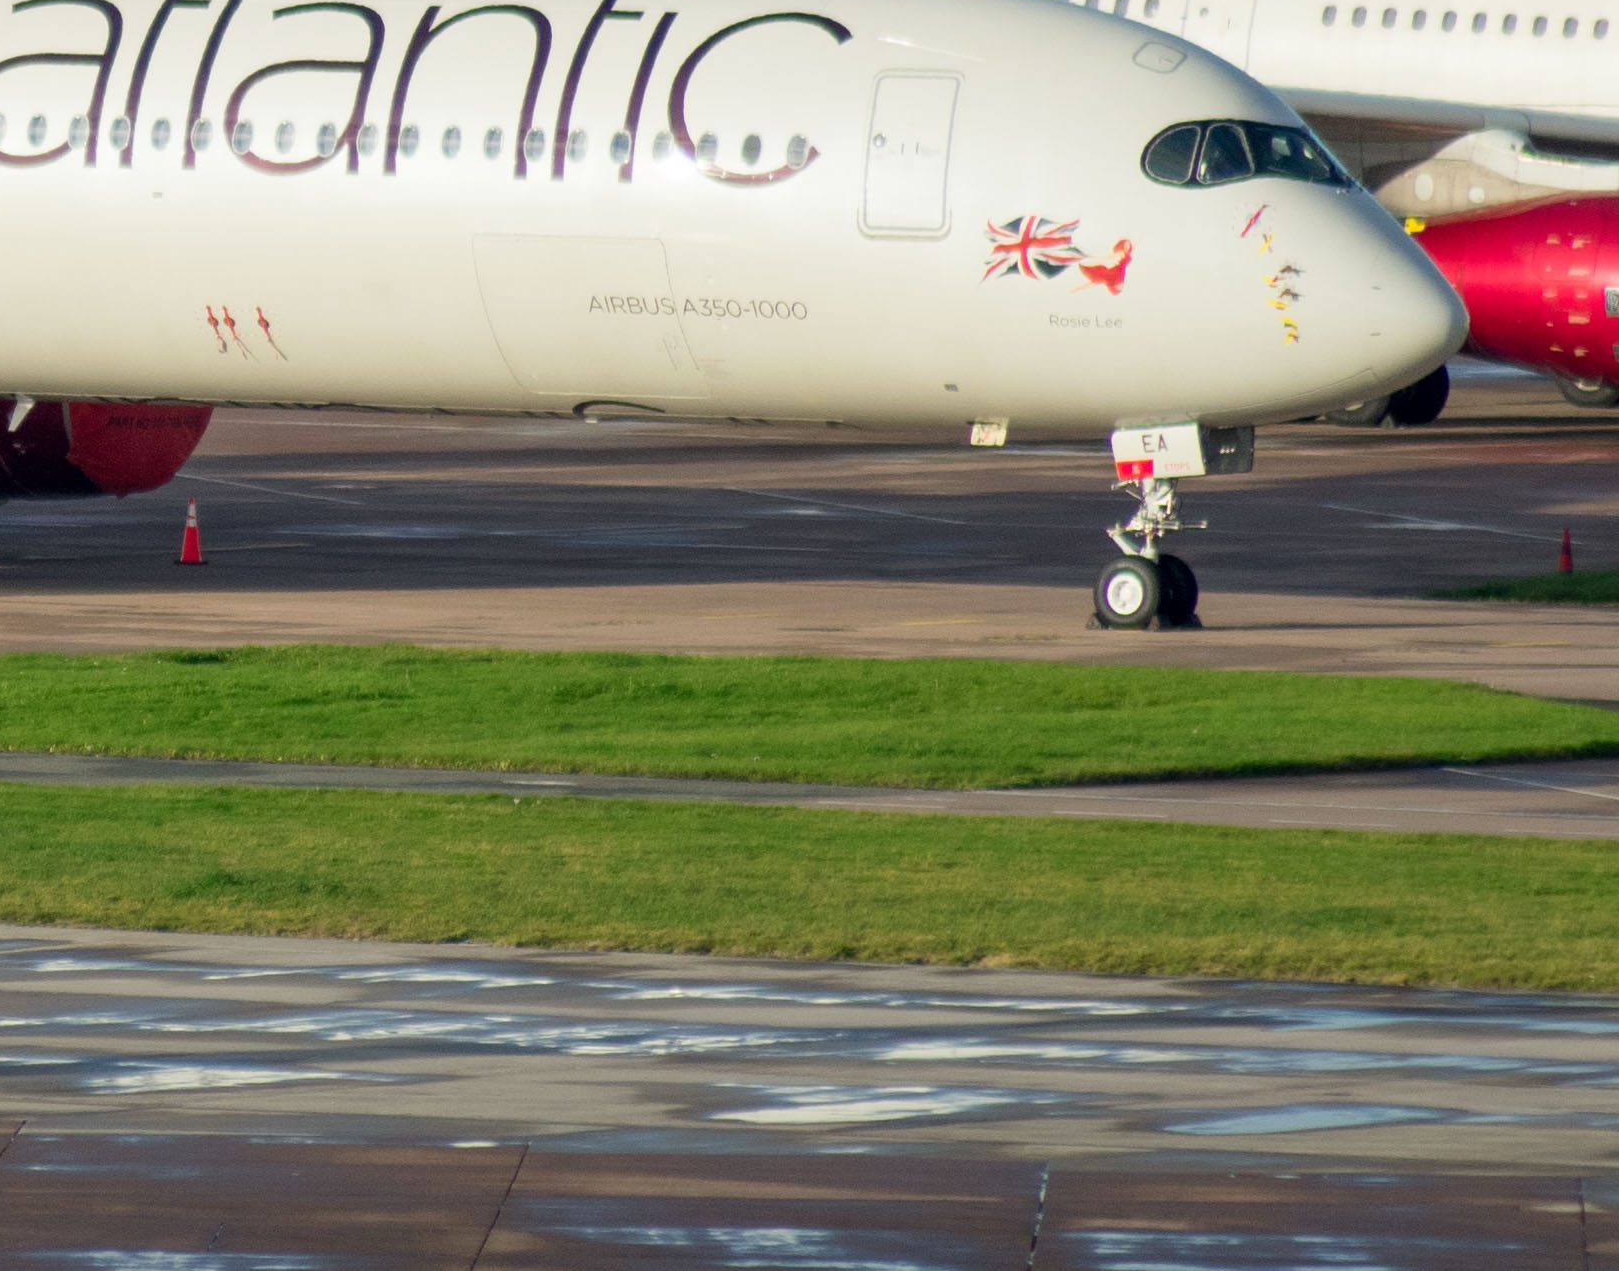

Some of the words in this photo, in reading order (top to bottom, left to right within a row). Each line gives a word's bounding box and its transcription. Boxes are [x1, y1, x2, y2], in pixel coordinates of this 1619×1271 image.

[588, 294, 675, 316] AIRBUS
[682, 297, 808, 321] A350-1000
[1142, 433, 1168, 453] EA
